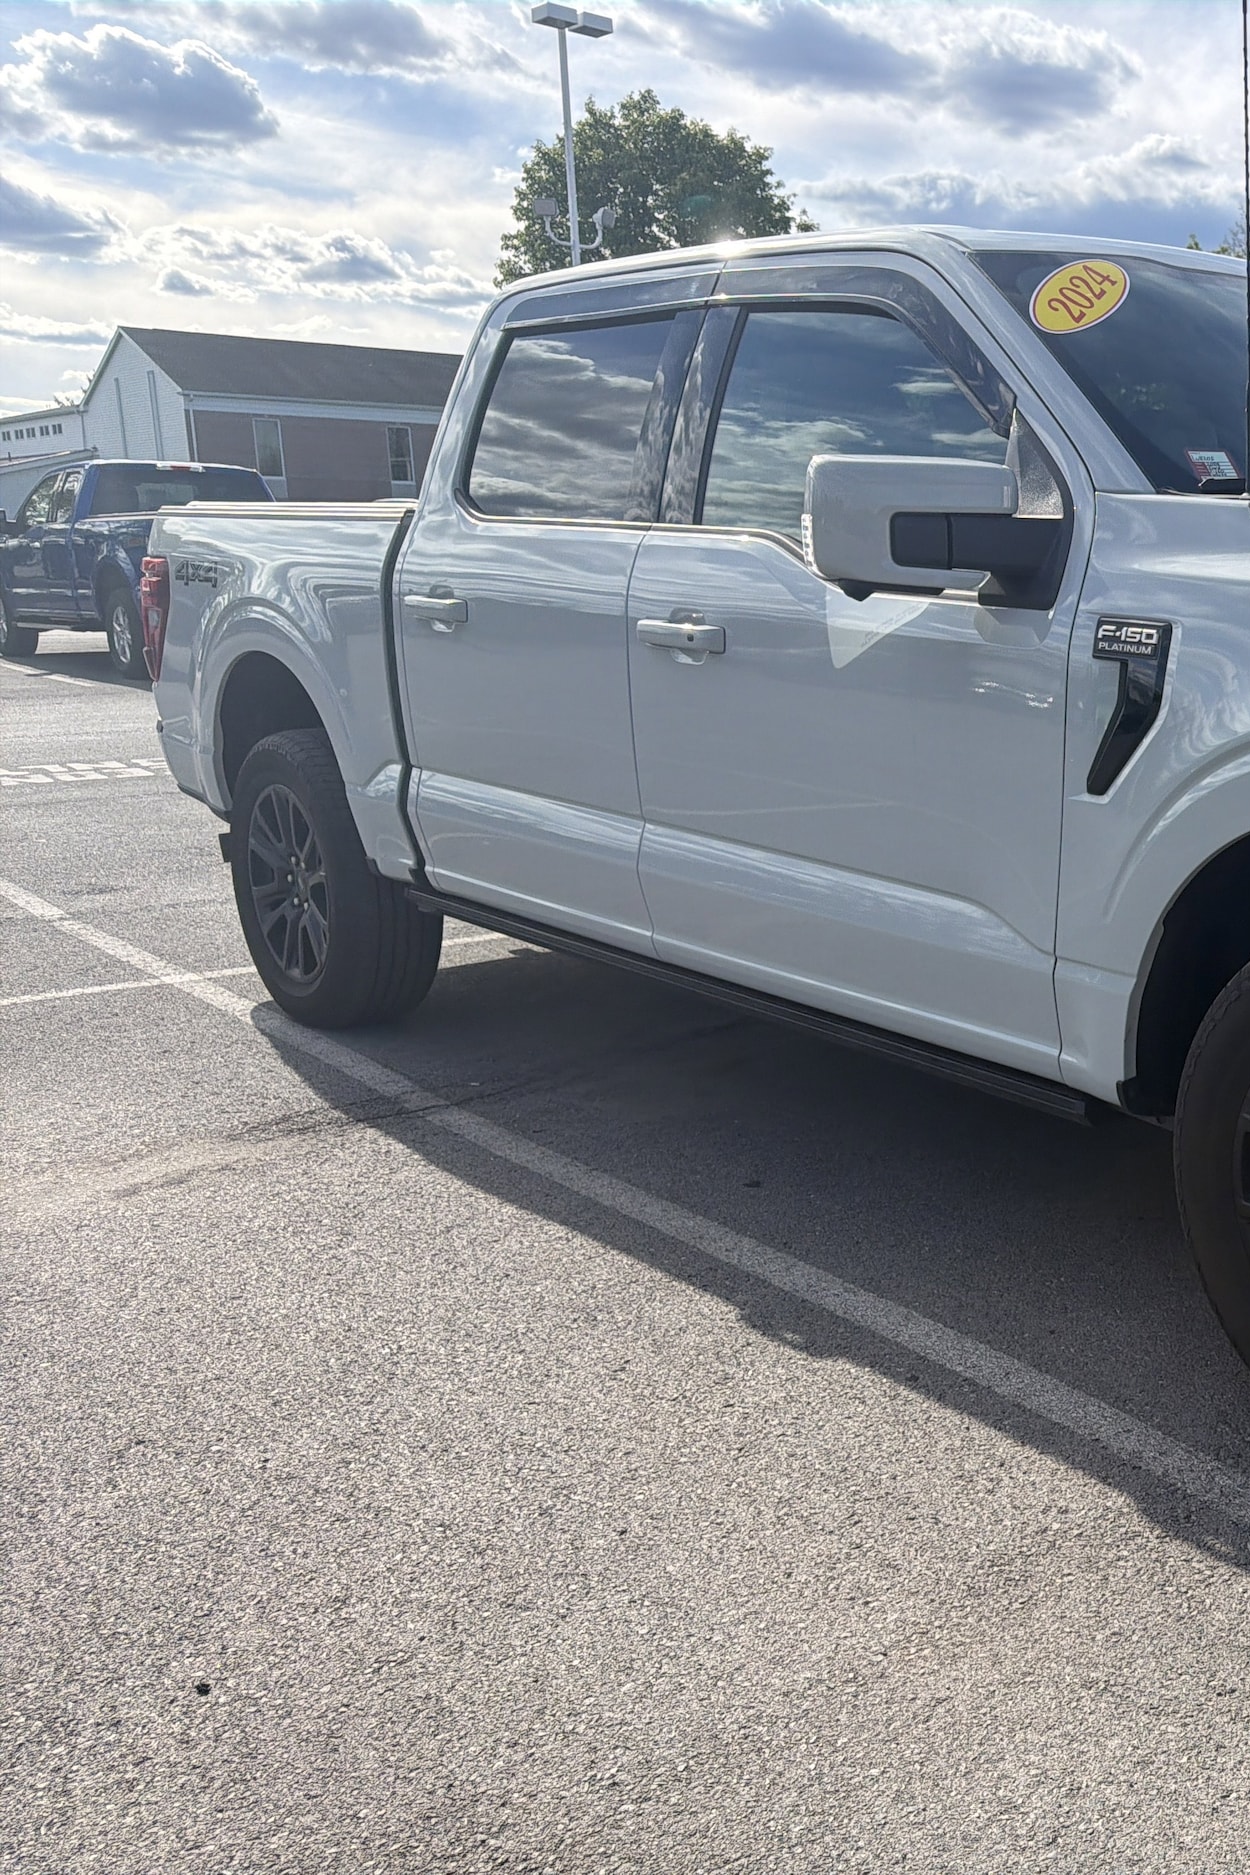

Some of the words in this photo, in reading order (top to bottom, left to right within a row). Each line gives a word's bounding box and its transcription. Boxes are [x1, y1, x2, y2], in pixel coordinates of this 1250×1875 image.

[1047, 264, 1118, 324] 2024
[1097, 624, 1160, 645] F-150
[1098, 642, 1152, 655] PLATINUM
